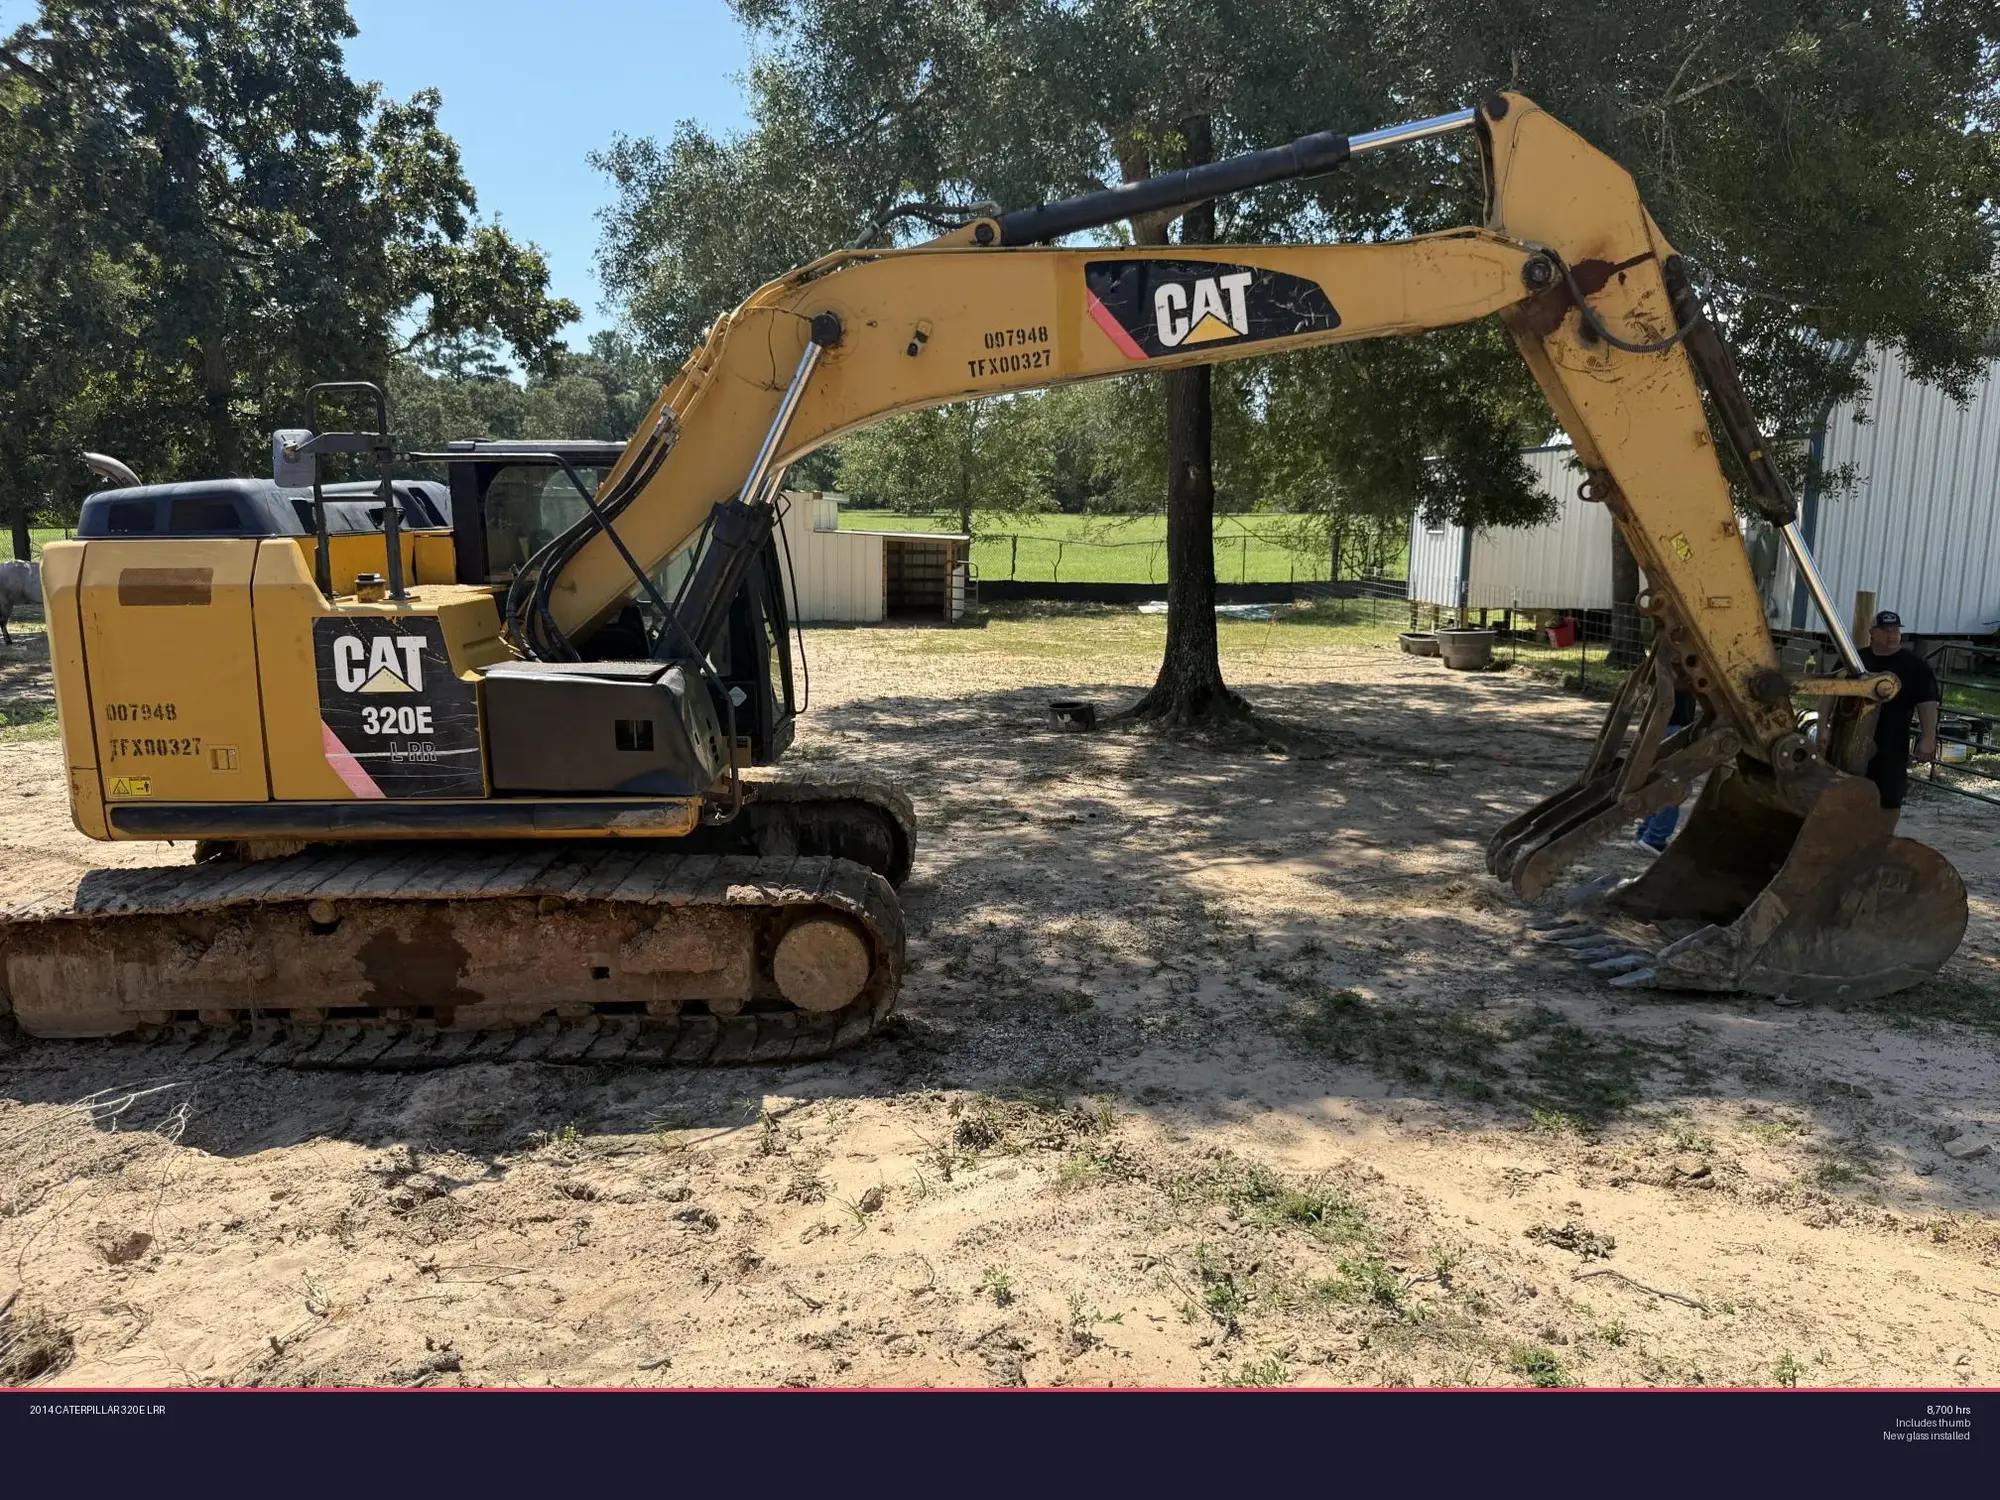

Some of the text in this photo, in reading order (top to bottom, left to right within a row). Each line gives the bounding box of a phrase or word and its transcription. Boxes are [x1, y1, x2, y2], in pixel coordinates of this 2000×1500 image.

[1154, 272, 1252, 347] CAT
[968, 349, 1051, 378] TFX00327
[333, 635, 427, 693] CAT
[107, 703, 177, 721] 007948
[361, 706, 434, 735] 320E
[110, 737, 201, 757] TFX00327
[390, 741, 437, 762] L RR
